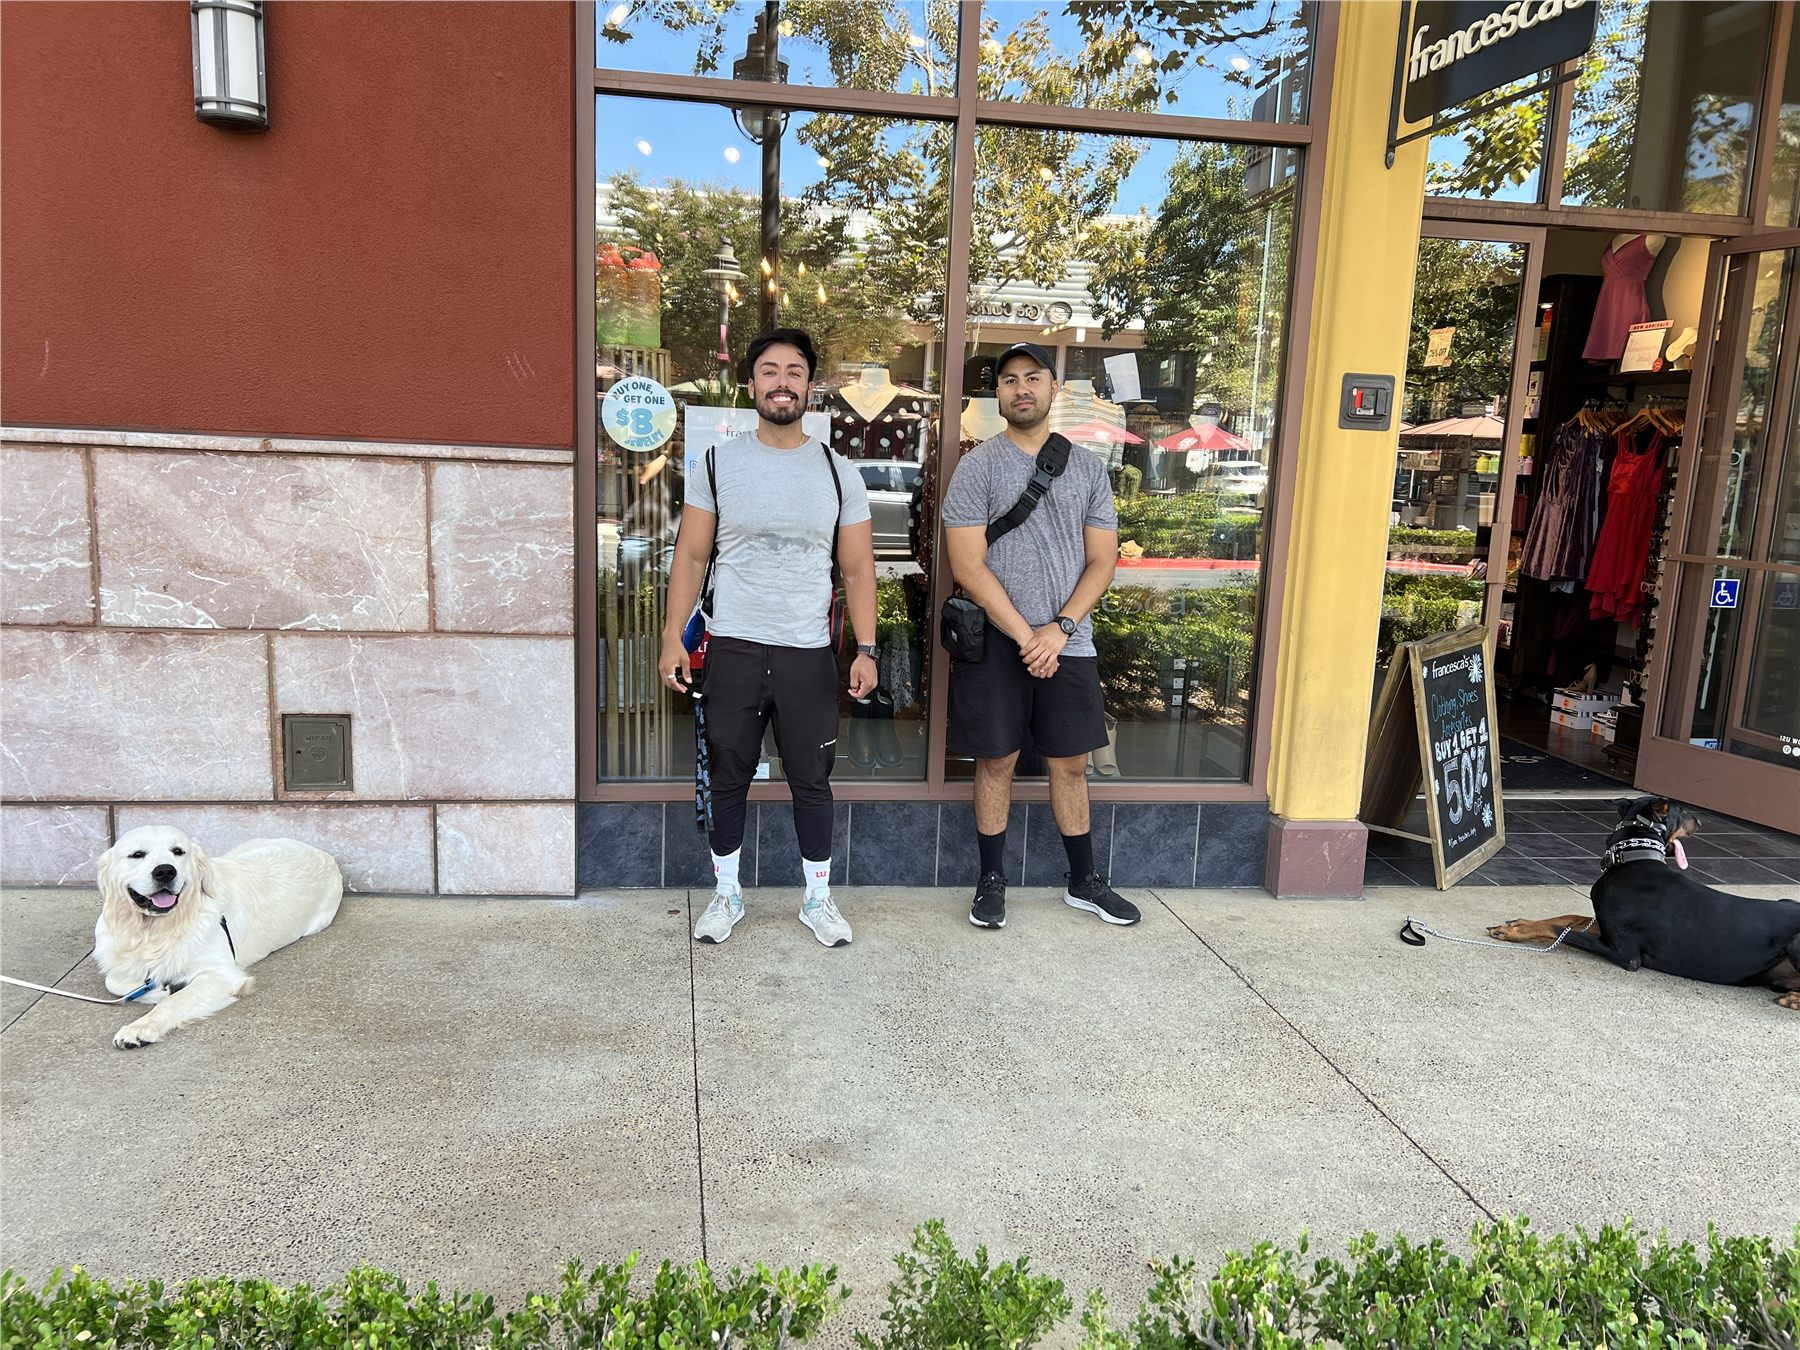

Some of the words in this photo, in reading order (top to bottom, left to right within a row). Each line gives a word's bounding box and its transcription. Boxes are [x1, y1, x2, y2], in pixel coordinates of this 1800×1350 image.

[611, 383, 630, 401] BUY
[631, 381, 654, 395] ONE,
[623, 394, 643, 404] GET
[644, 395, 666, 405] ONE
[616, 408, 654, 435] $8
[624, 429, 665, 448] JEWELRY
[1432, 654, 1470, 679] francesca's
[1458, 688, 1479, 708] Shoes
[1434, 737, 1452, 762] BUY
[1452, 732, 1461, 756] 1
[1460, 726, 1478, 751] GET
[1478, 716, 1488, 745] 1
[1442, 745, 1488, 825] 50%
